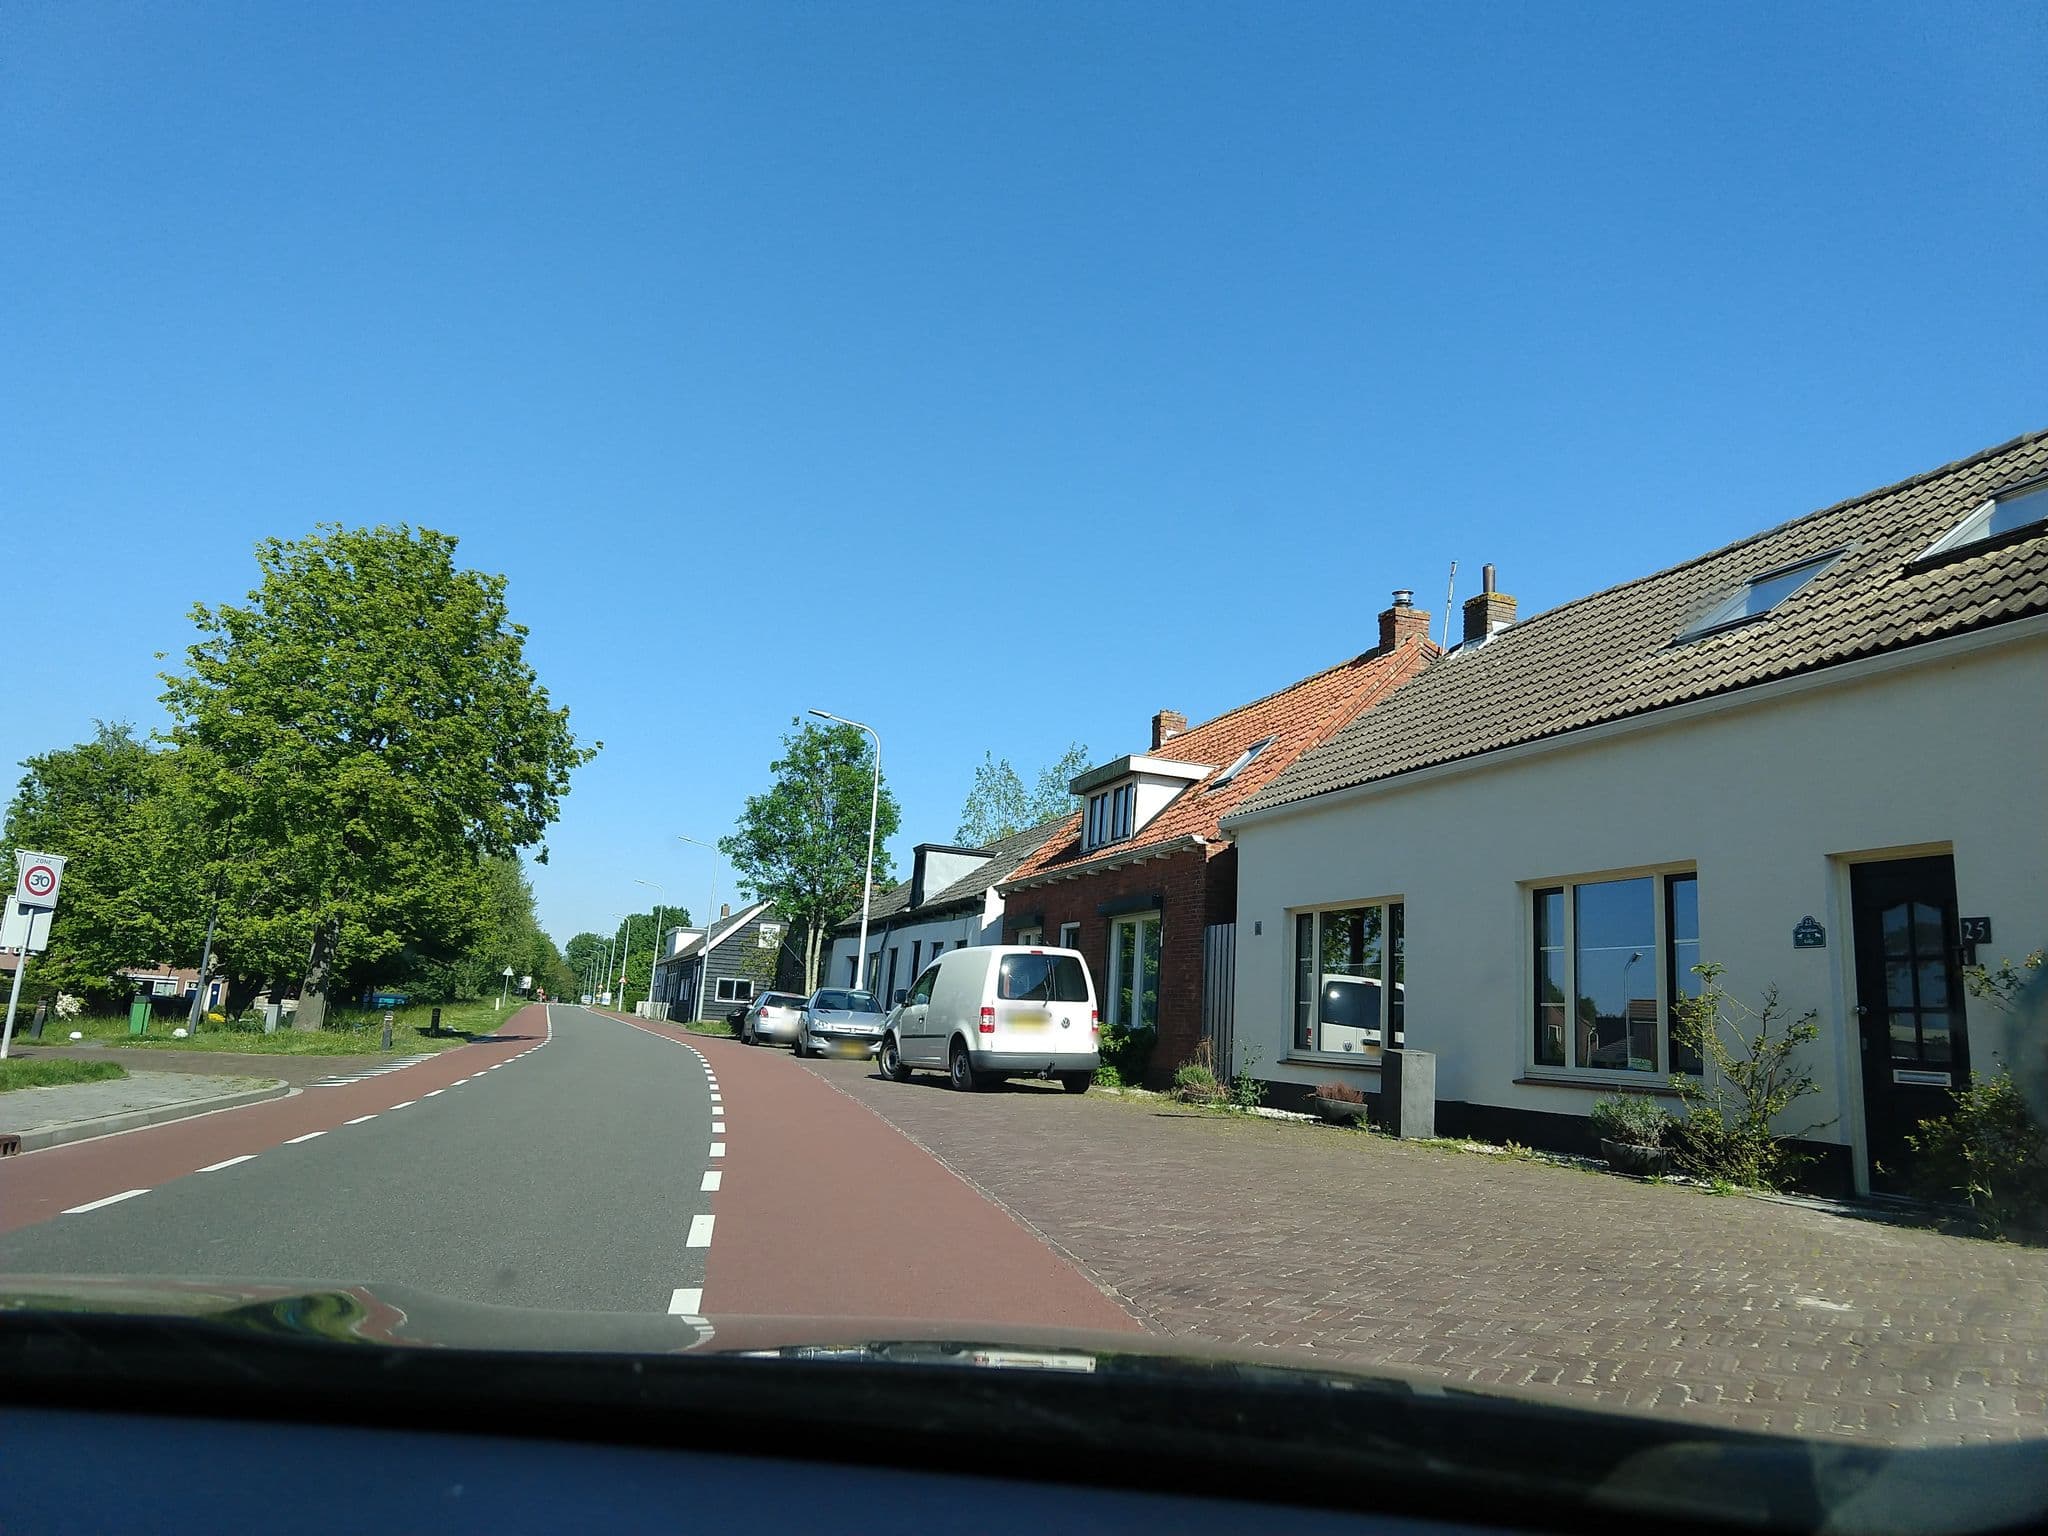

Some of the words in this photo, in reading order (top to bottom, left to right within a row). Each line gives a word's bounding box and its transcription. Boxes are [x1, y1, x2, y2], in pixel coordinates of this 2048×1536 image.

[35, 857, 52, 865] ZONE
[30, 874, 50, 888] 30
[1964, 921, 1985, 940] 25
